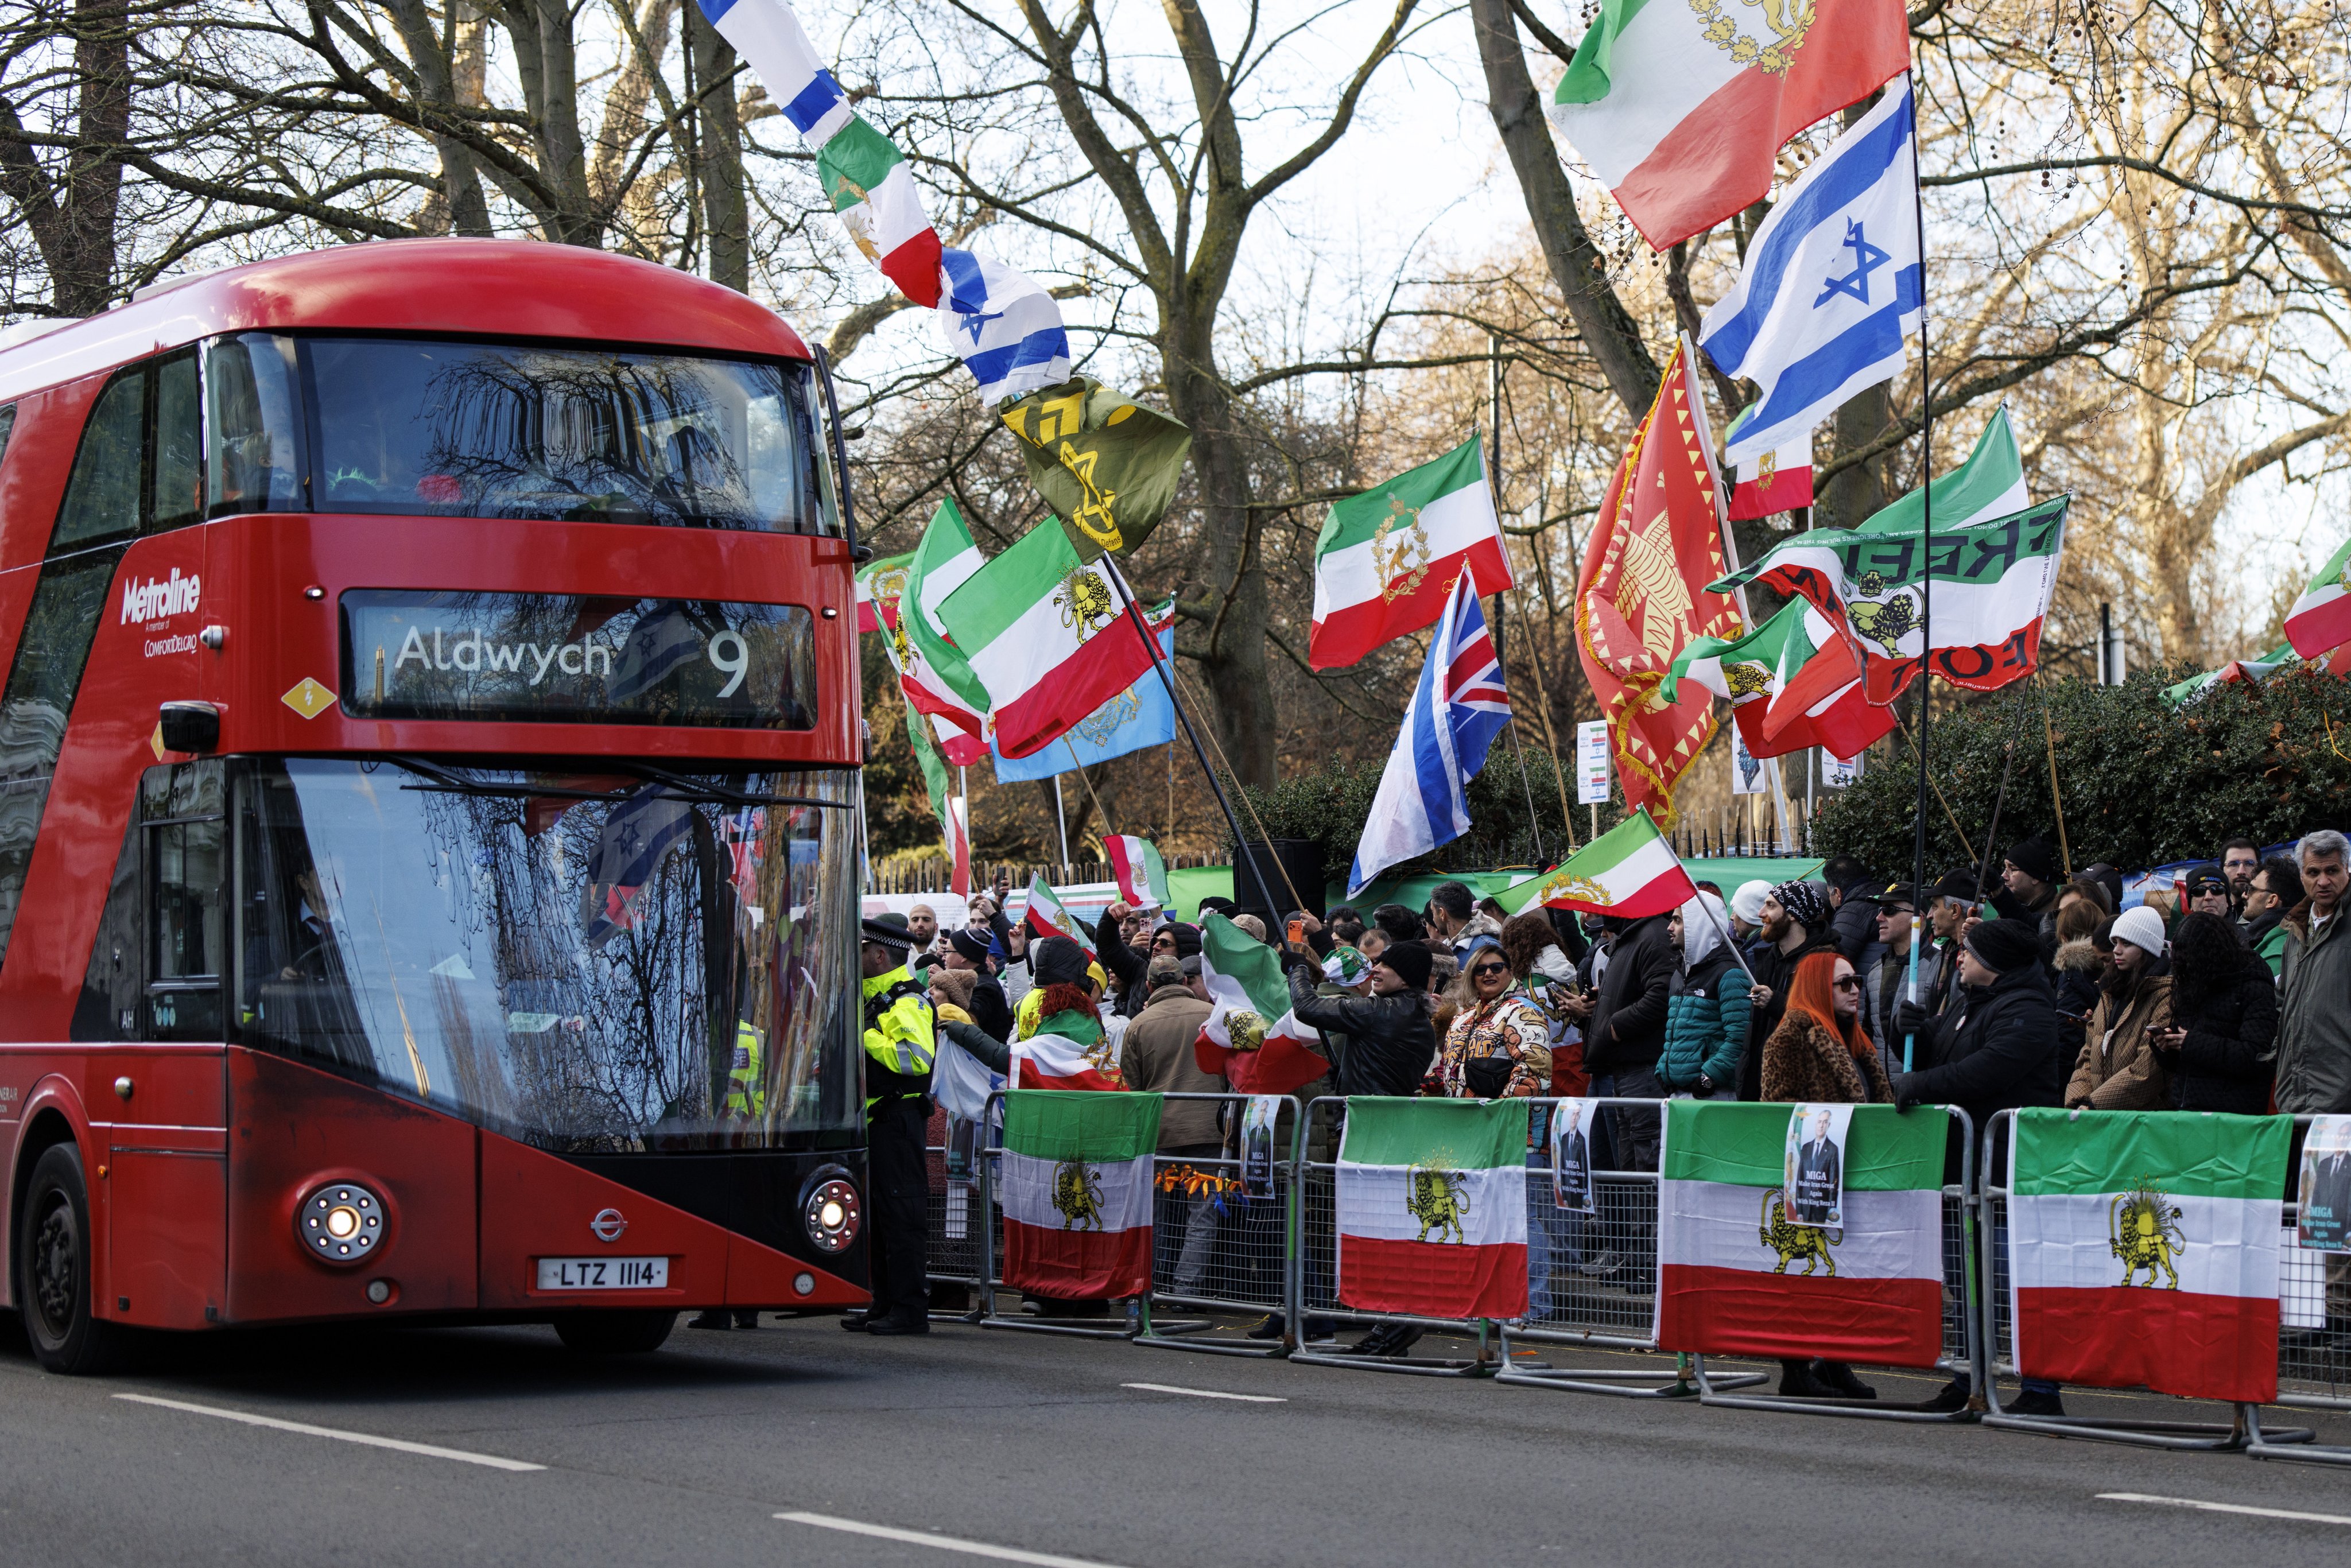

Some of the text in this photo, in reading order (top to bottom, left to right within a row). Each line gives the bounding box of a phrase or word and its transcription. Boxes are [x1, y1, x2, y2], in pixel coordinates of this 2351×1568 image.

[1101, 534, 1122, 548] Defens
[1842, 533, 1884, 542] FOREIGNERS
[121, 567, 200, 625] Metroline
[149, 620, 165, 632] member
[395, 626, 748, 698] Aldwych 9
[122, 1010, 134, 1029] AH
[1566, 1160, 1580, 1169] MIGA
[1806, 1170, 1826, 1180] MIGA
[1809, 1199, 1819, 1207] King
[2310, 1206, 2333, 1217] MIGA
[561, 1262, 654, 1286] LTZ 1114
